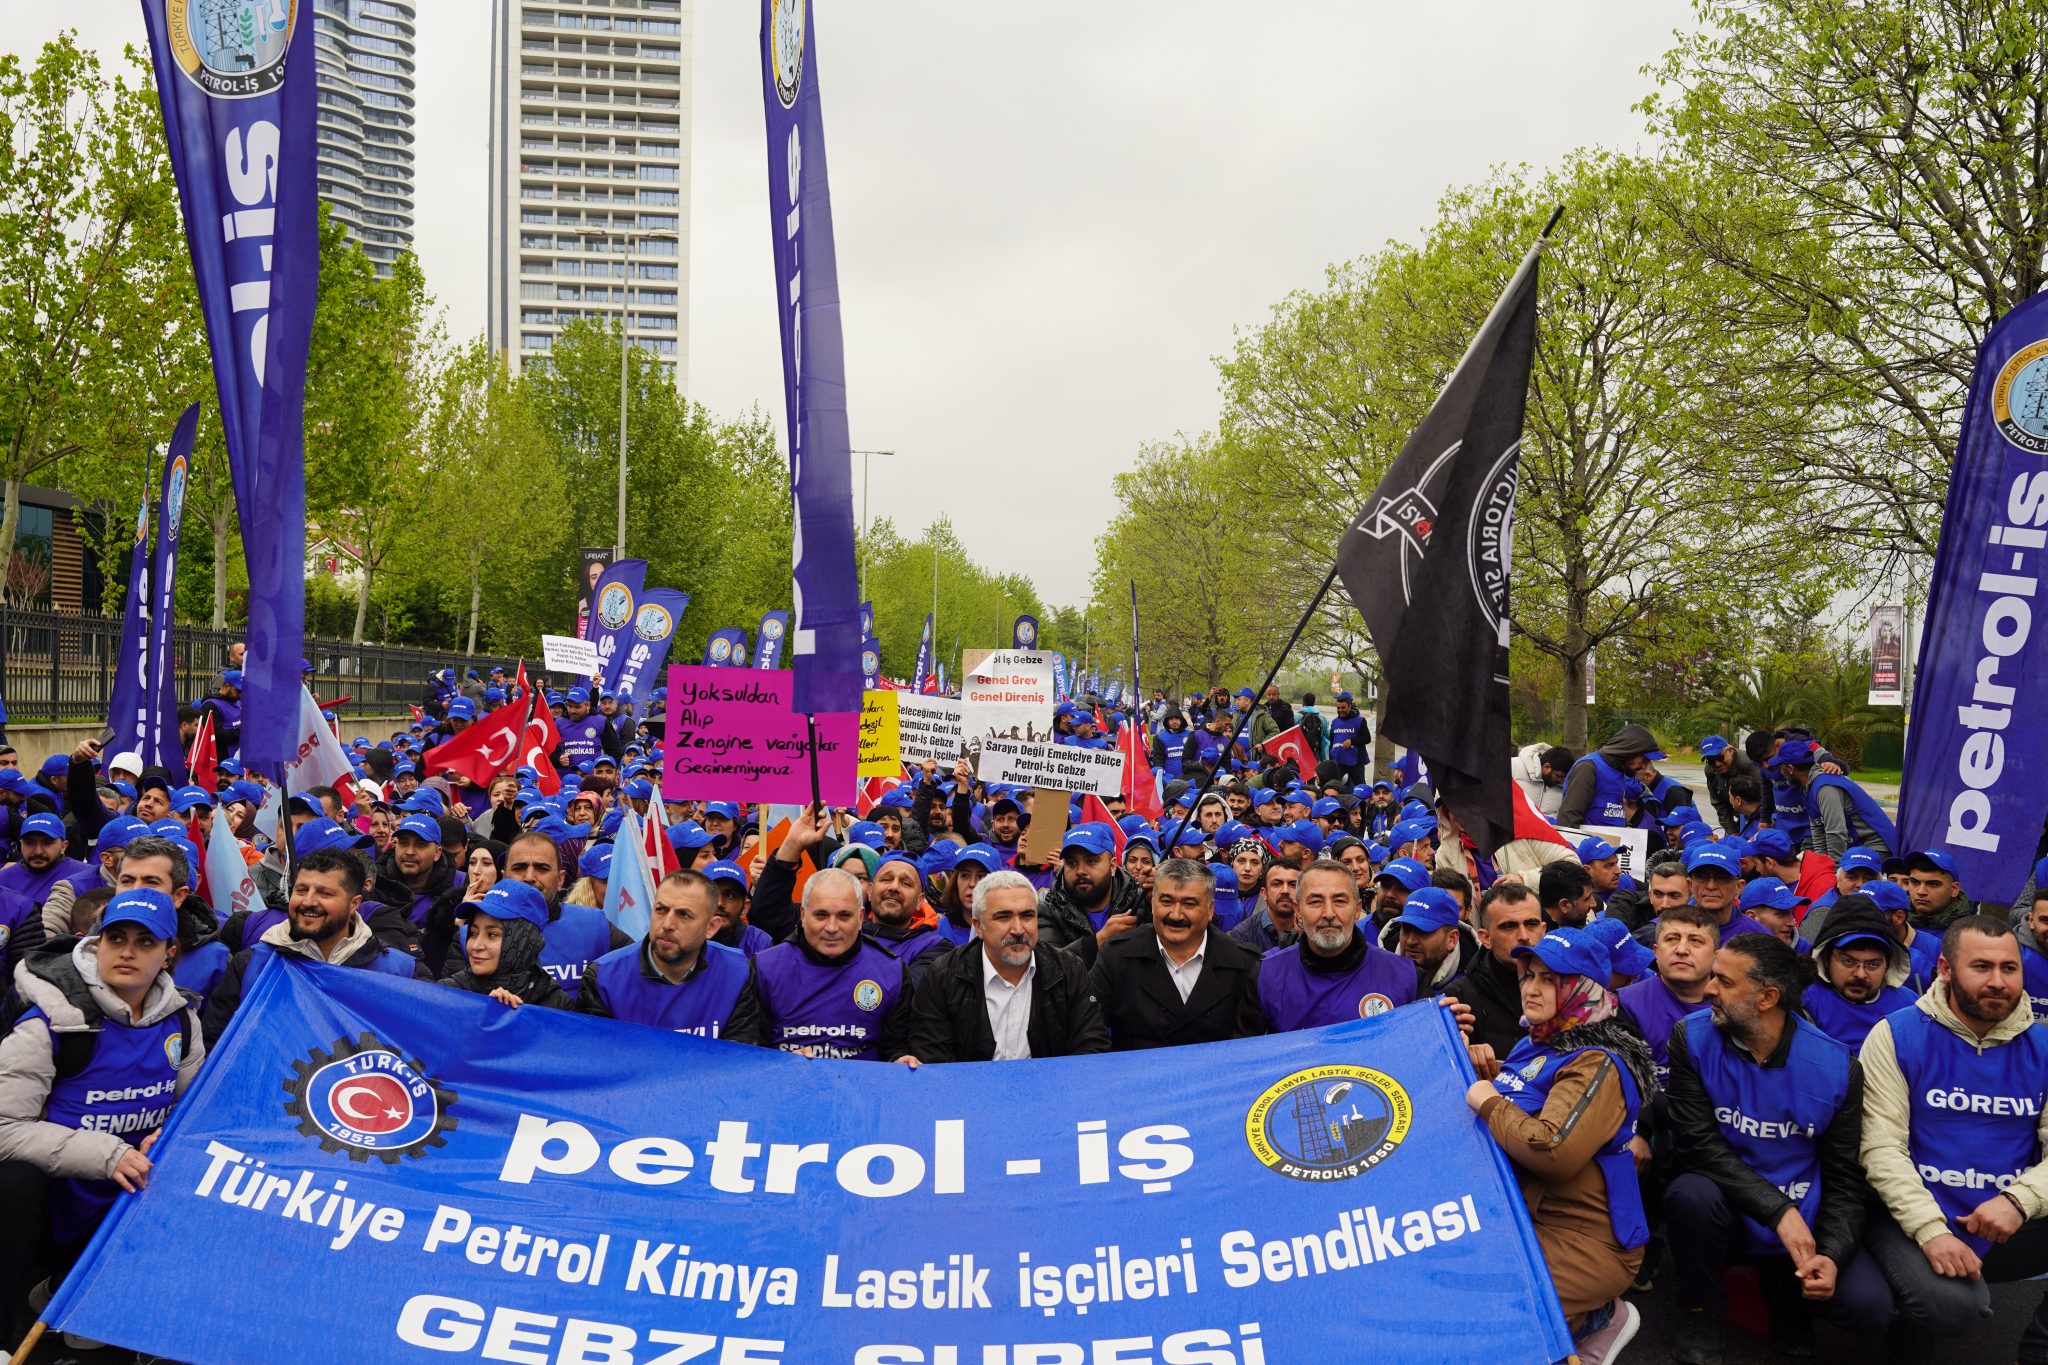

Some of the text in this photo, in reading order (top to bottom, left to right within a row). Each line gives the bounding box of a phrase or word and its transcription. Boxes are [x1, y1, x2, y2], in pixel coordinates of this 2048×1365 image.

[200, 65, 285, 93] PETROL-İŞ 19
[2005, 423, 2048, 451] PETROL-İ
[1003, 654, 1012, 666] İş
[1013, 655, 1043, 664] Gebze
[977, 674, 1038, 685] Genel Grev
[681, 682, 780, 706] Yoksuldan
[970, 692, 1045, 704] Genel Direniş
[899, 731, 954, 748] etrol-İş Gebze
[932, 723, 949, 735] Geri
[676, 731, 754, 756] Zengine
[908, 745, 932, 759] Kimya
[985, 740, 1018, 757] Saraya
[1047, 747, 1093, 768] Emekçiye
[1094, 751, 1122, 768] Bütçe
[1001, 766, 1099, 793] Pulver Kimya İşçileri
[1014, 758, 1086, 777] Petrol-İş Gebze
[783, 1024, 867, 1040] petrol-iş
[85, 1080, 176, 1105] petrol-iş
[1252, 1096, 1275, 1124] PETROL
[1274, 1075, 1308, 1095] KİMYA
[1311, 1068, 1352, 1079] LASTİK
[1391, 1090, 1408, 1134] SENDİKASI
[1925, 1086, 2043, 1117] GÖREVLİ
[329, 1122, 376, 1146] 1952
[497, 1113, 965, 1199] petrol
[1077, 1119, 1195, 1195] iş
[1360, 1142, 1395, 1169] 1950
[195, 1140, 1481, 1319] Türkiye Petrol Kimya Lastik işçileri Sendikası
